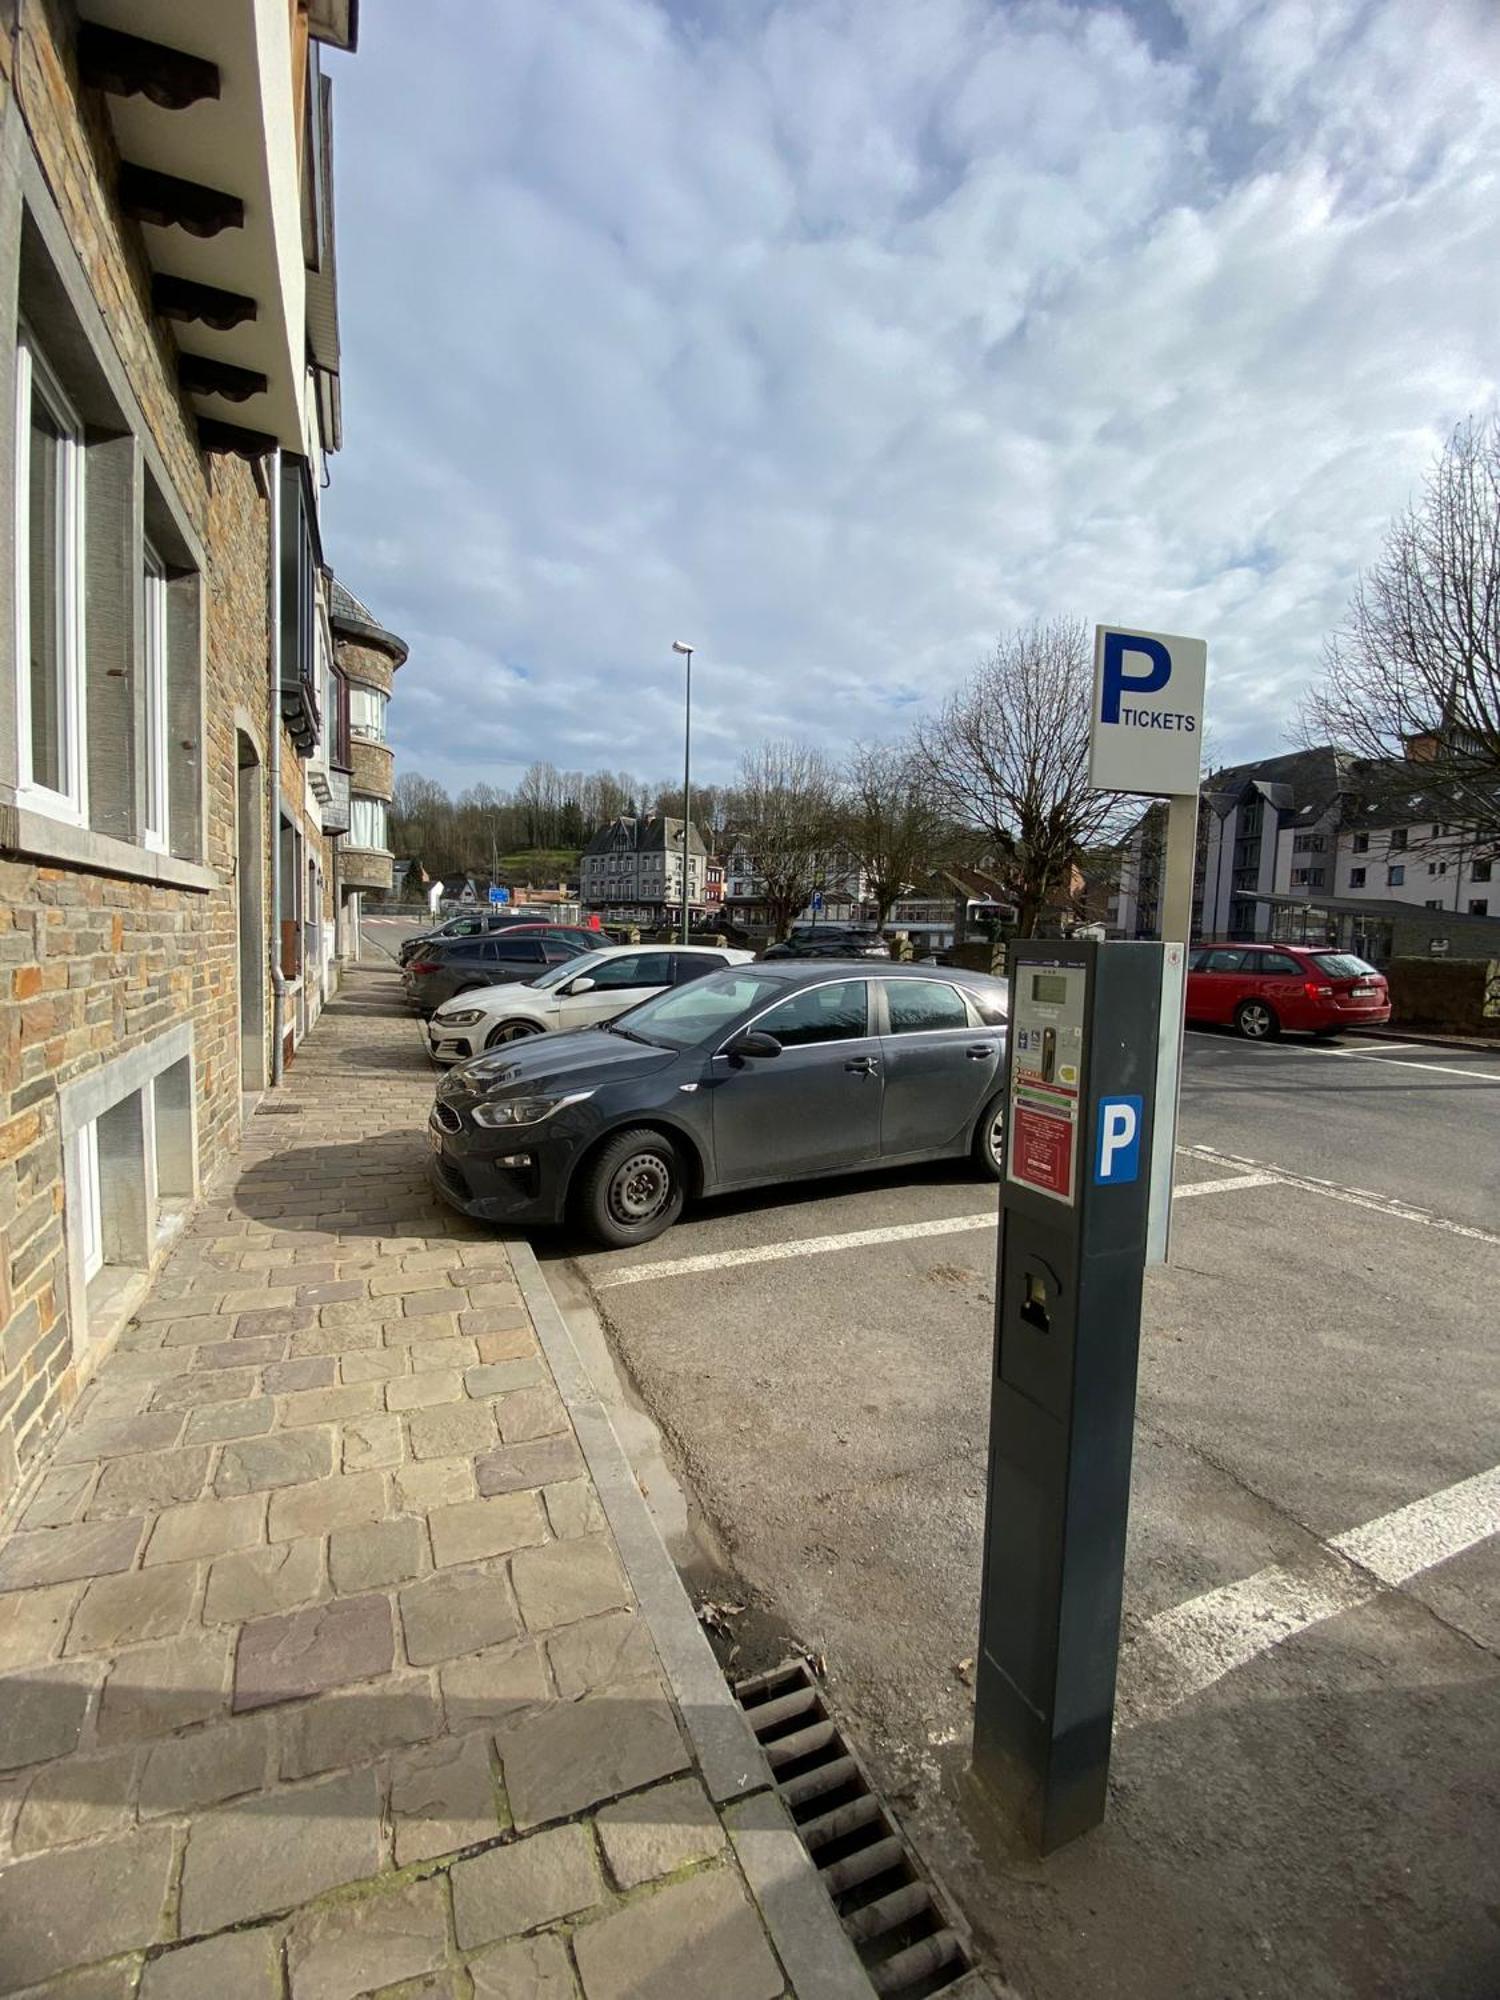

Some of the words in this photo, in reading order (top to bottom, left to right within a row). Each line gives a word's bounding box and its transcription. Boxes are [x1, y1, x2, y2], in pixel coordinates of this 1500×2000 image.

[1101, 632, 1172, 724] P
[1122, 708, 1196, 732] TICKETS
[1100, 1104, 1136, 1177] P
